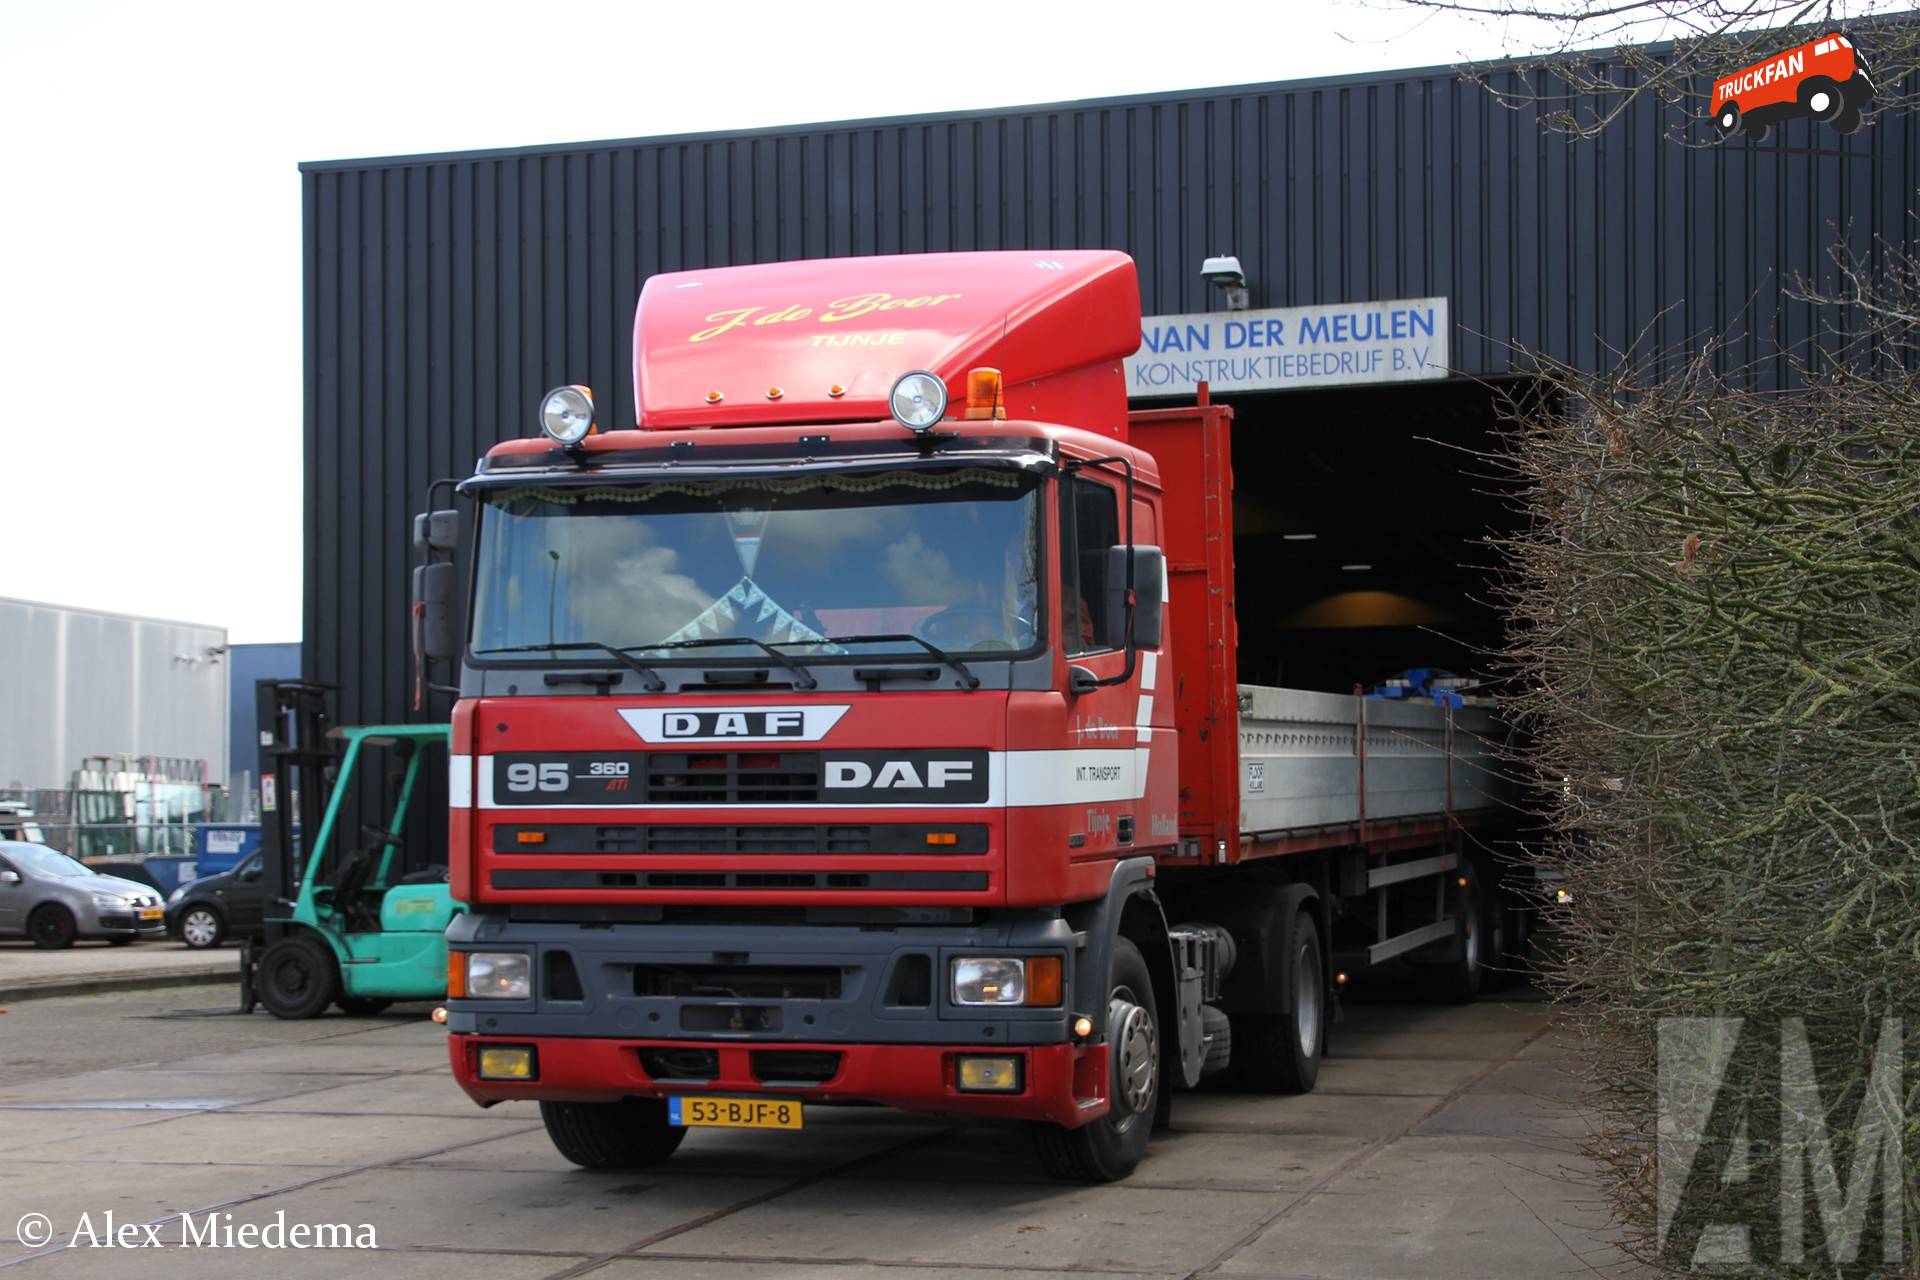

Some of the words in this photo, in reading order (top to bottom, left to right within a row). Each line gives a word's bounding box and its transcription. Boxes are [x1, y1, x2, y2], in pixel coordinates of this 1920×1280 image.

[819, 293, 962, 322] Boer
[811, 333, 907, 347] TIJNJE
[1224, 319, 1285, 349] DER
[1298, 308, 1434, 345] MEULEN
[1136, 349, 1383, 386] KONSTRUKTIEBEDRIJF
[664, 713, 801, 736] DAF
[507, 763, 570, 793] 95
[589, 762, 629, 775] 360
[825, 760, 973, 788] DAF
[1089, 766, 1120, 781] TRANSPORT
[692, 1102, 790, 1124] 53-BJF-8
